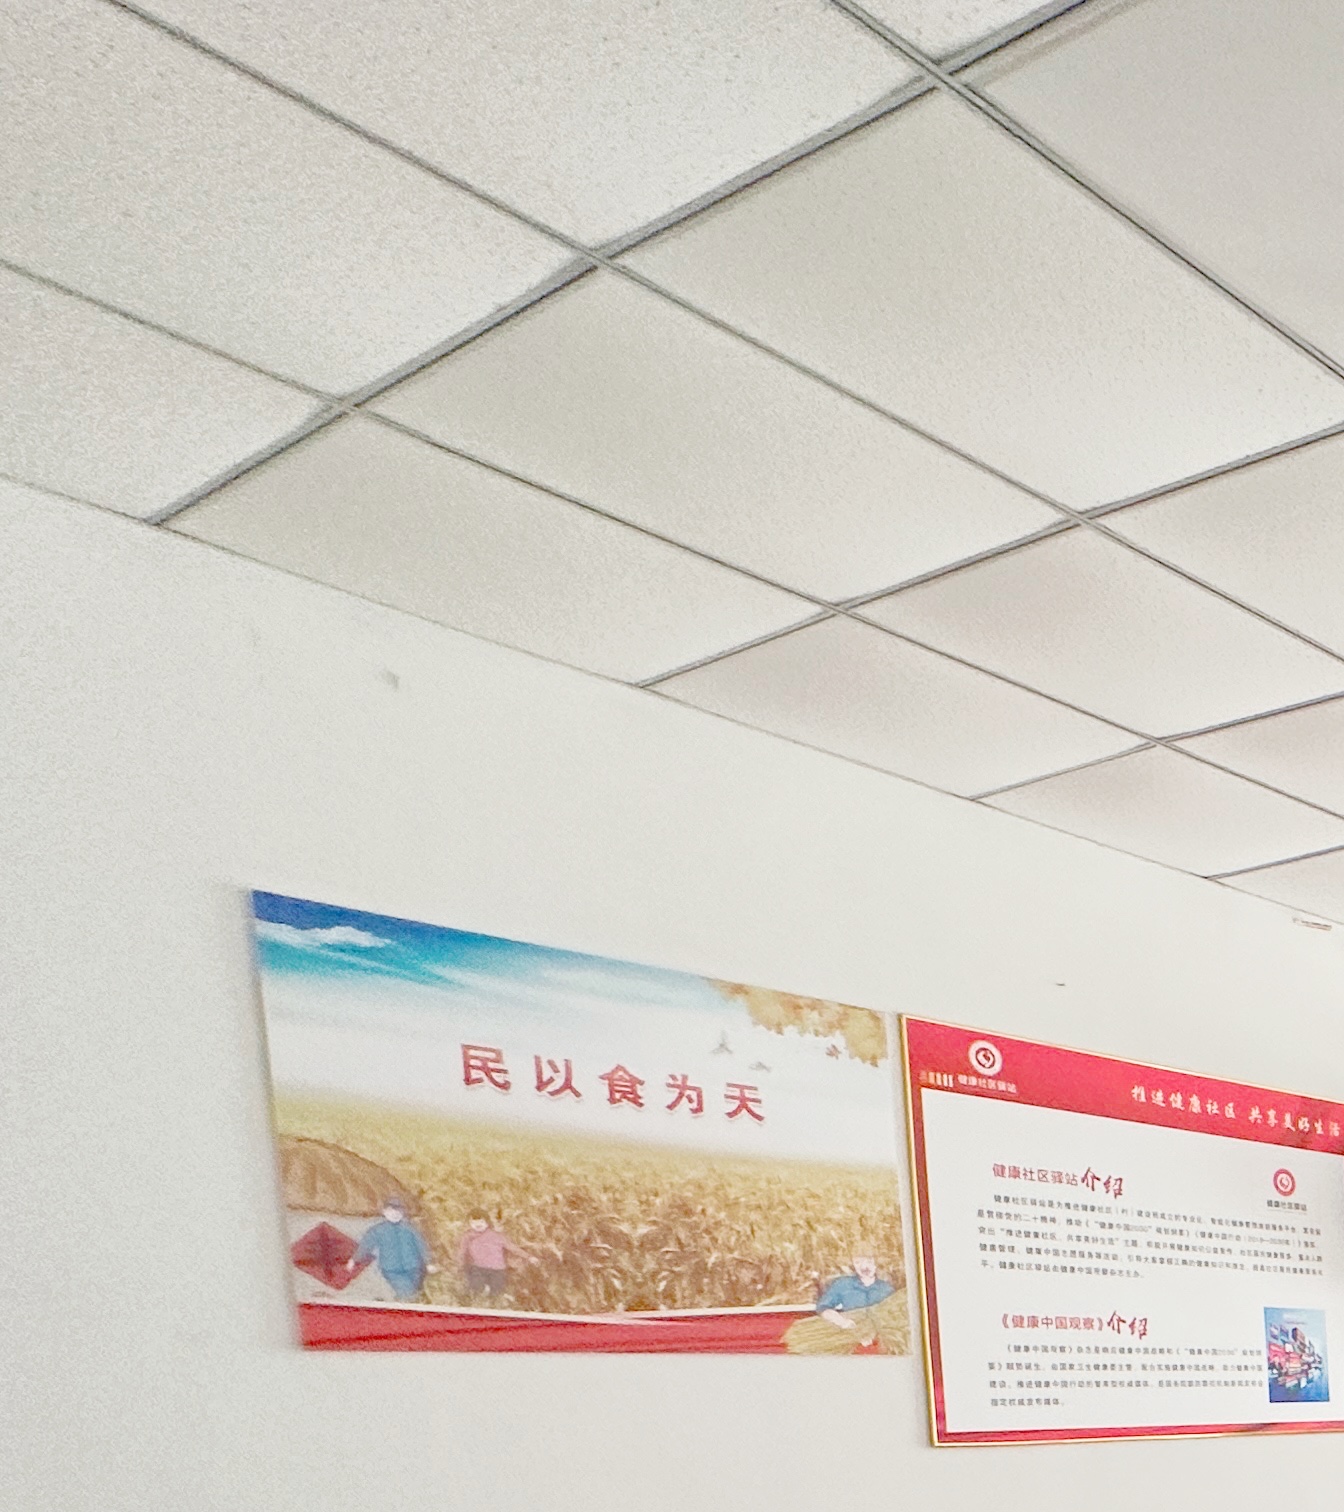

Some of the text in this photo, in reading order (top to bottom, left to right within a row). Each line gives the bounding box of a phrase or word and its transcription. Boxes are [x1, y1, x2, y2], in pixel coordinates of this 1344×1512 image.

[460, 1042, 768, 1124] 民以食为天
[1131, 1084, 1341, 1138] 推进健康社区 共享美好生活
